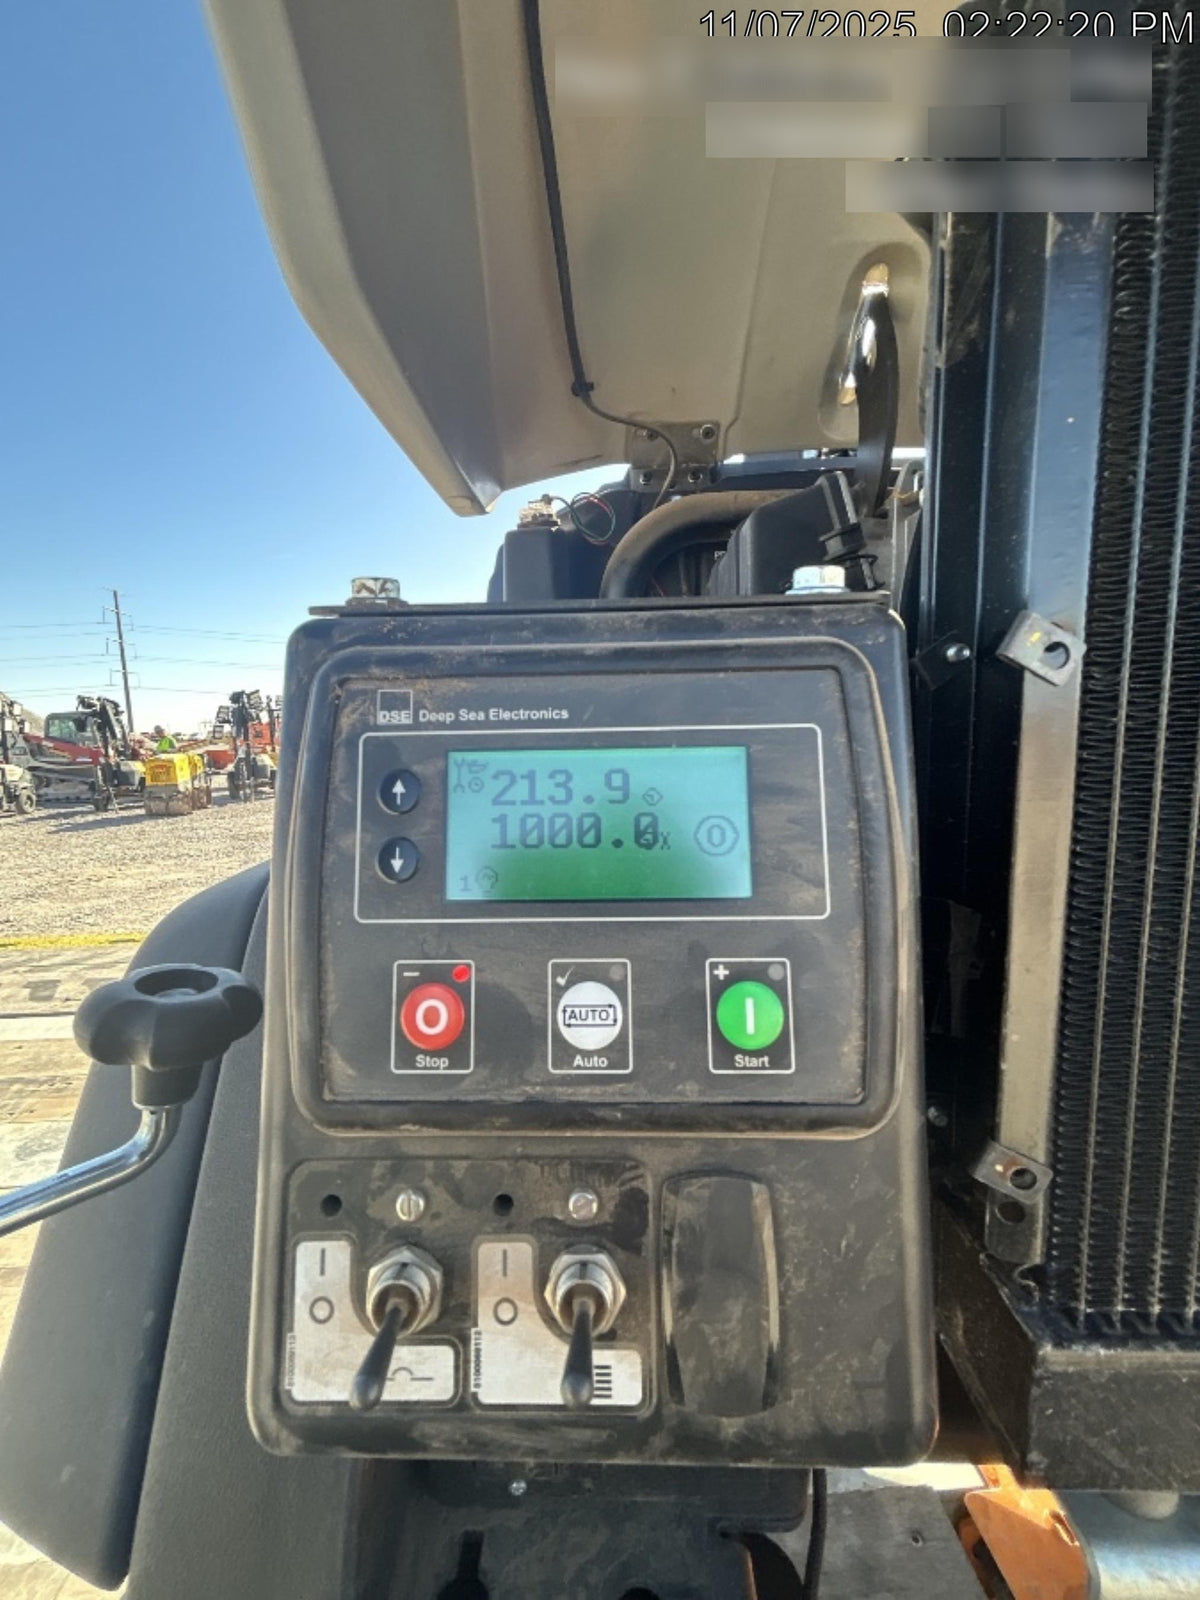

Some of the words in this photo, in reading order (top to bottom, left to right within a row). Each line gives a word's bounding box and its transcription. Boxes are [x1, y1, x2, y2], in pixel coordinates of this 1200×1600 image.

[378, 709, 412, 724] DSE
[419, 709, 455, 724] Deep
[459, 708, 485, 721] Sea
[489, 707, 569, 720] Electronics
[490, 768, 631, 806] 213.9
[490, 811, 660, 850] 1000.0
[567, 1008, 611, 1022] AUTO
[415, 1054, 449, 1070] Stop
[573, 1055, 608, 1068] Auto
[734, 1054, 770, 1068] Start
